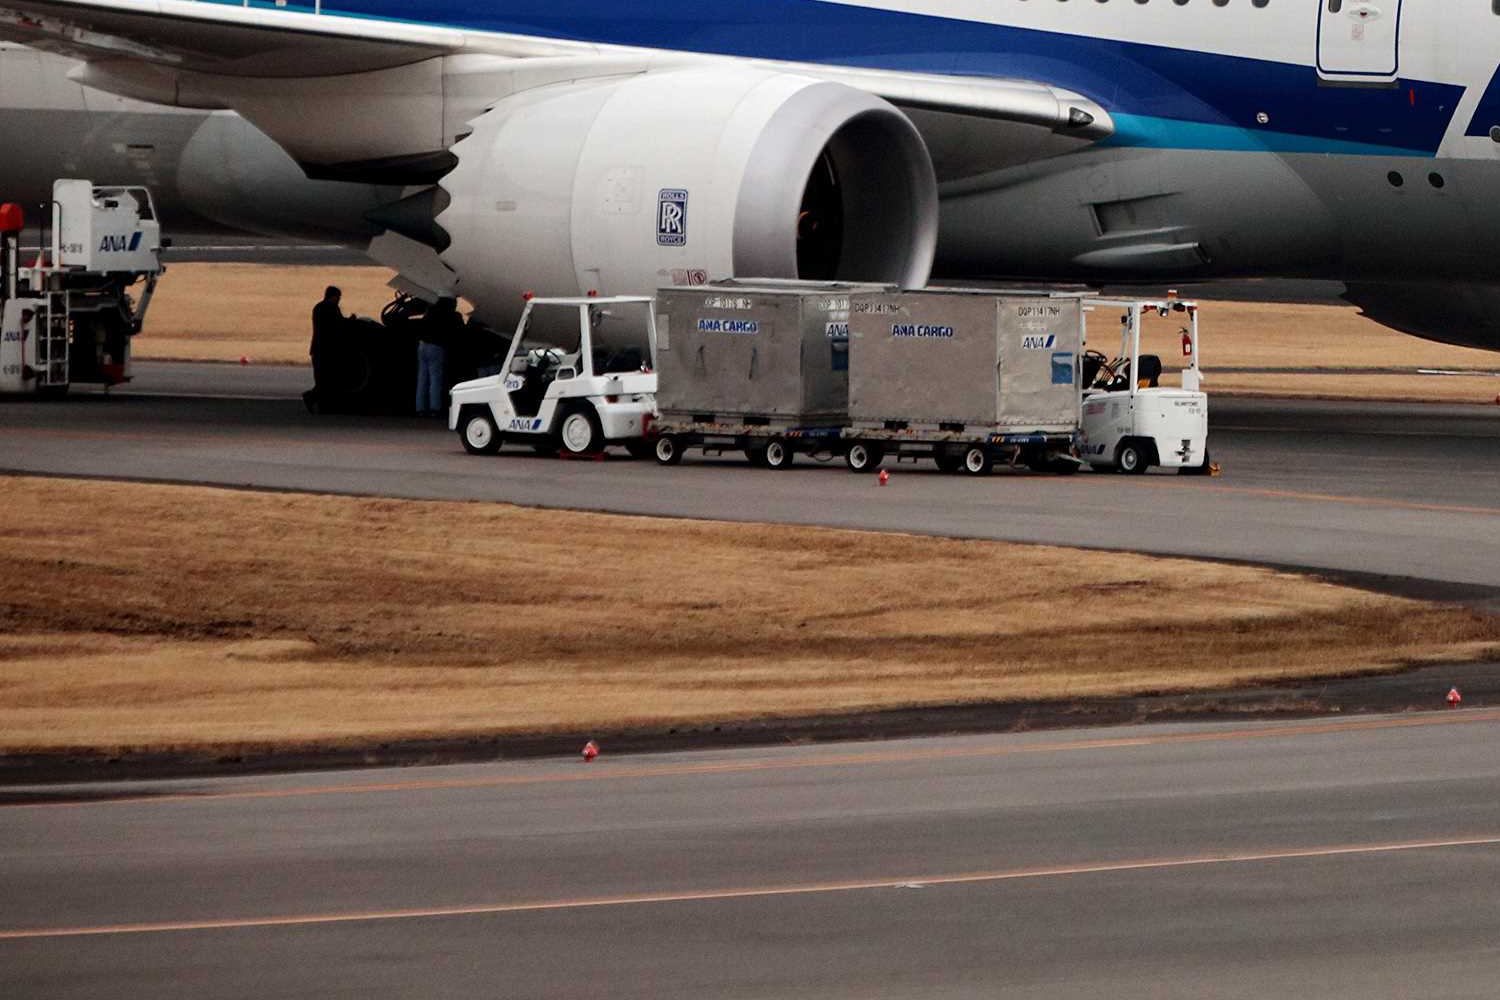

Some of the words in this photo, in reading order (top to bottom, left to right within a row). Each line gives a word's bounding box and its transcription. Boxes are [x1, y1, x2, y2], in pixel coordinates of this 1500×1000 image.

[100, 235, 127, 251] ANA
[699, 320, 720, 331] ANA
[723, 320, 757, 332] CARGO
[828, 324, 848, 336] ANA
[893, 325, 915, 336] ANA
[918, 325, 953, 337] CARGO
[1023, 337, 1044, 349] ANA
[510, 419, 530, 430] ANA
